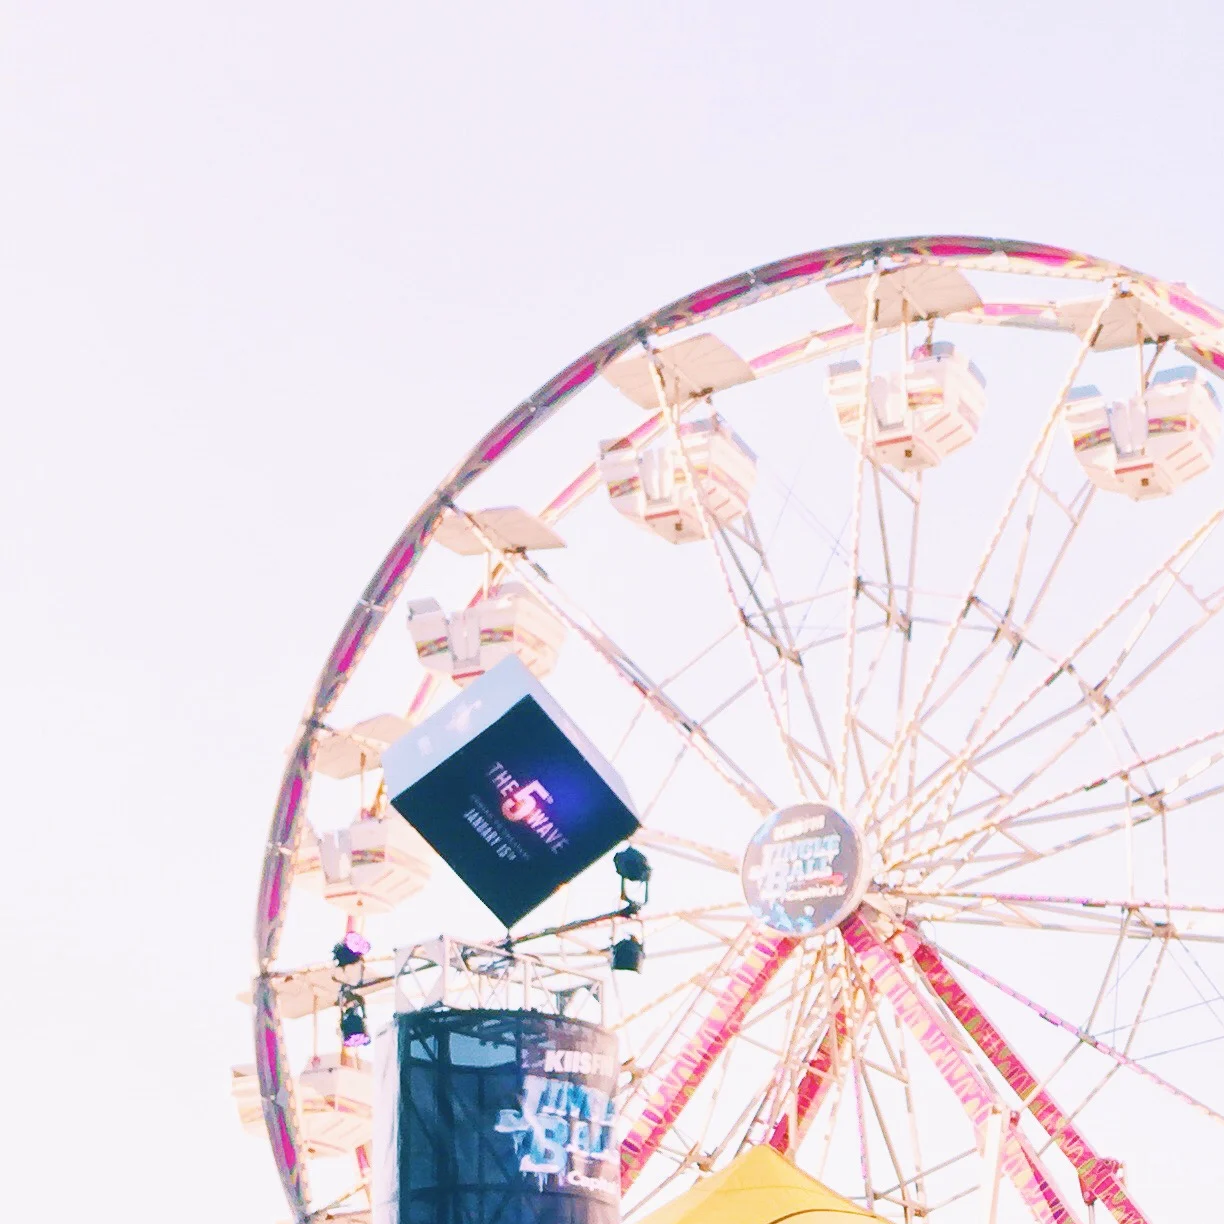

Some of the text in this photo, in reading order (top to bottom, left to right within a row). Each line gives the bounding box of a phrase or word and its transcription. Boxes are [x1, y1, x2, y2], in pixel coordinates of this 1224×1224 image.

[462, 808, 502, 847] JANUARY
[488, 762, 520, 797] THE
[526, 808, 570, 855] WAVE
